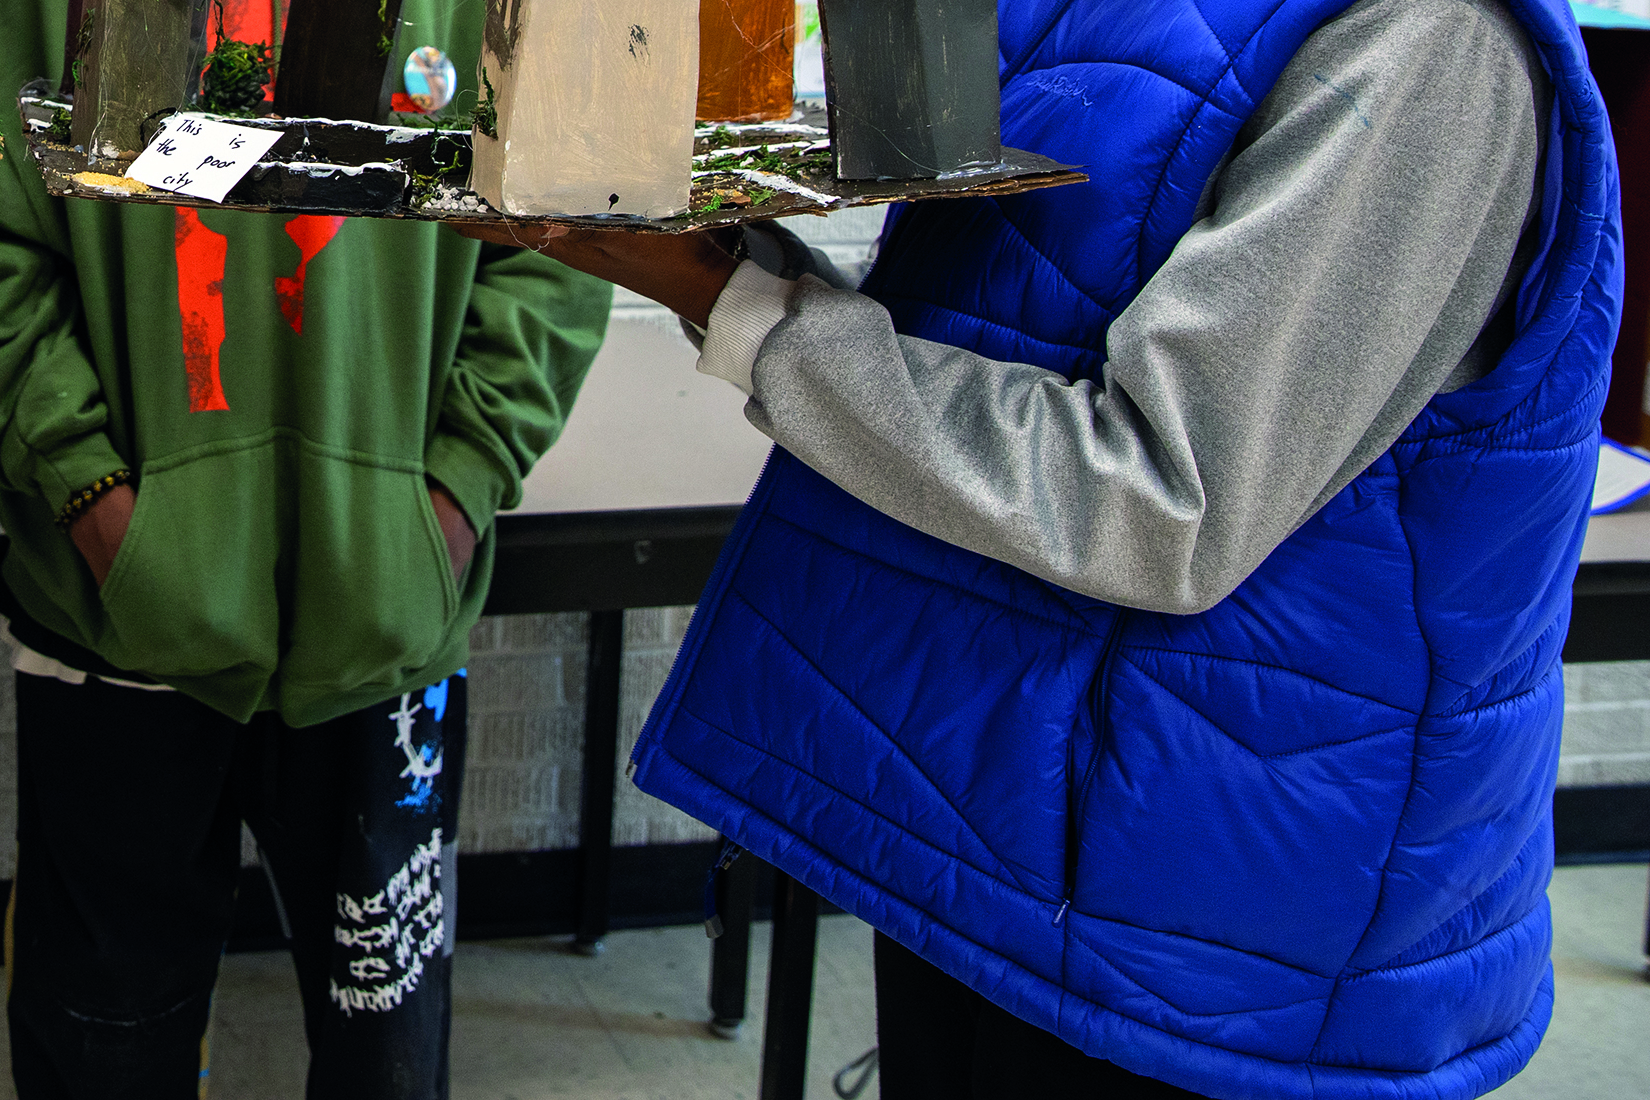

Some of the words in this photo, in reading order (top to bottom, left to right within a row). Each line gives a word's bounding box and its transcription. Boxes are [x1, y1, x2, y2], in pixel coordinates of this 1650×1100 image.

[176, 119, 202, 136] This
[229, 133, 246, 150] is
[156, 138, 177, 157] the
[196, 155, 236, 170] poor
[163, 172, 193, 192] city
